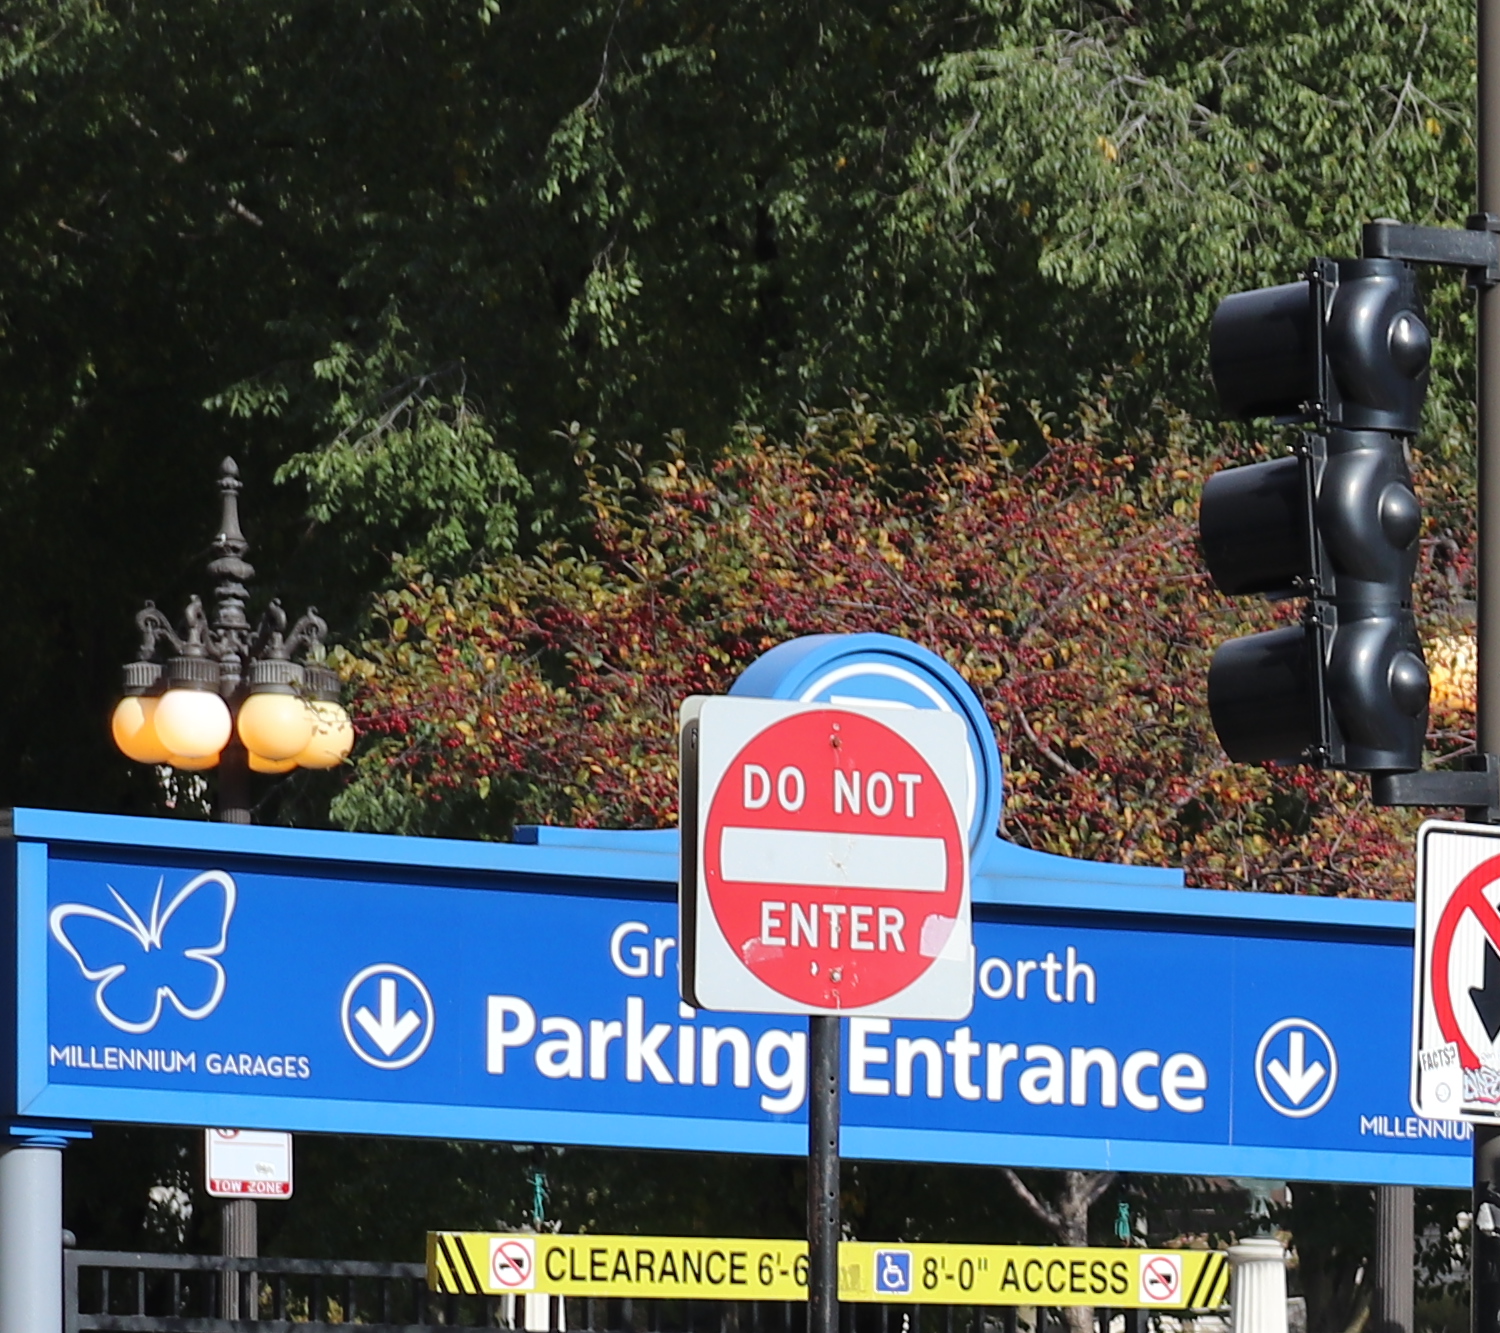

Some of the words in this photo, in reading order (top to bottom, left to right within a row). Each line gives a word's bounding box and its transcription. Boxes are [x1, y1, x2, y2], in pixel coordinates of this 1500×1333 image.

[742, 764, 807, 812] DO
[833, 769, 924, 819] NOT
[760, 901, 906, 952] ENTER
[972, 945, 1097, 1004] orth
[49, 1043, 197, 1073] MILLENNIUM
[205, 1051, 311, 1080] GARAGES
[486, 995, 808, 1114] Parking
[847, 1017, 1208, 1113] Entrance
[1421, 1046, 1456, 1072] FACTS?
[214, 1179, 242, 1192] TOW
[247, 1180, 284, 1194] ZONE
[544, 1246, 748, 1286] CLEARANCE
[922, 1257, 989, 1291] 8'-0"
[999, 1259, 1130, 1295] ACCESS
